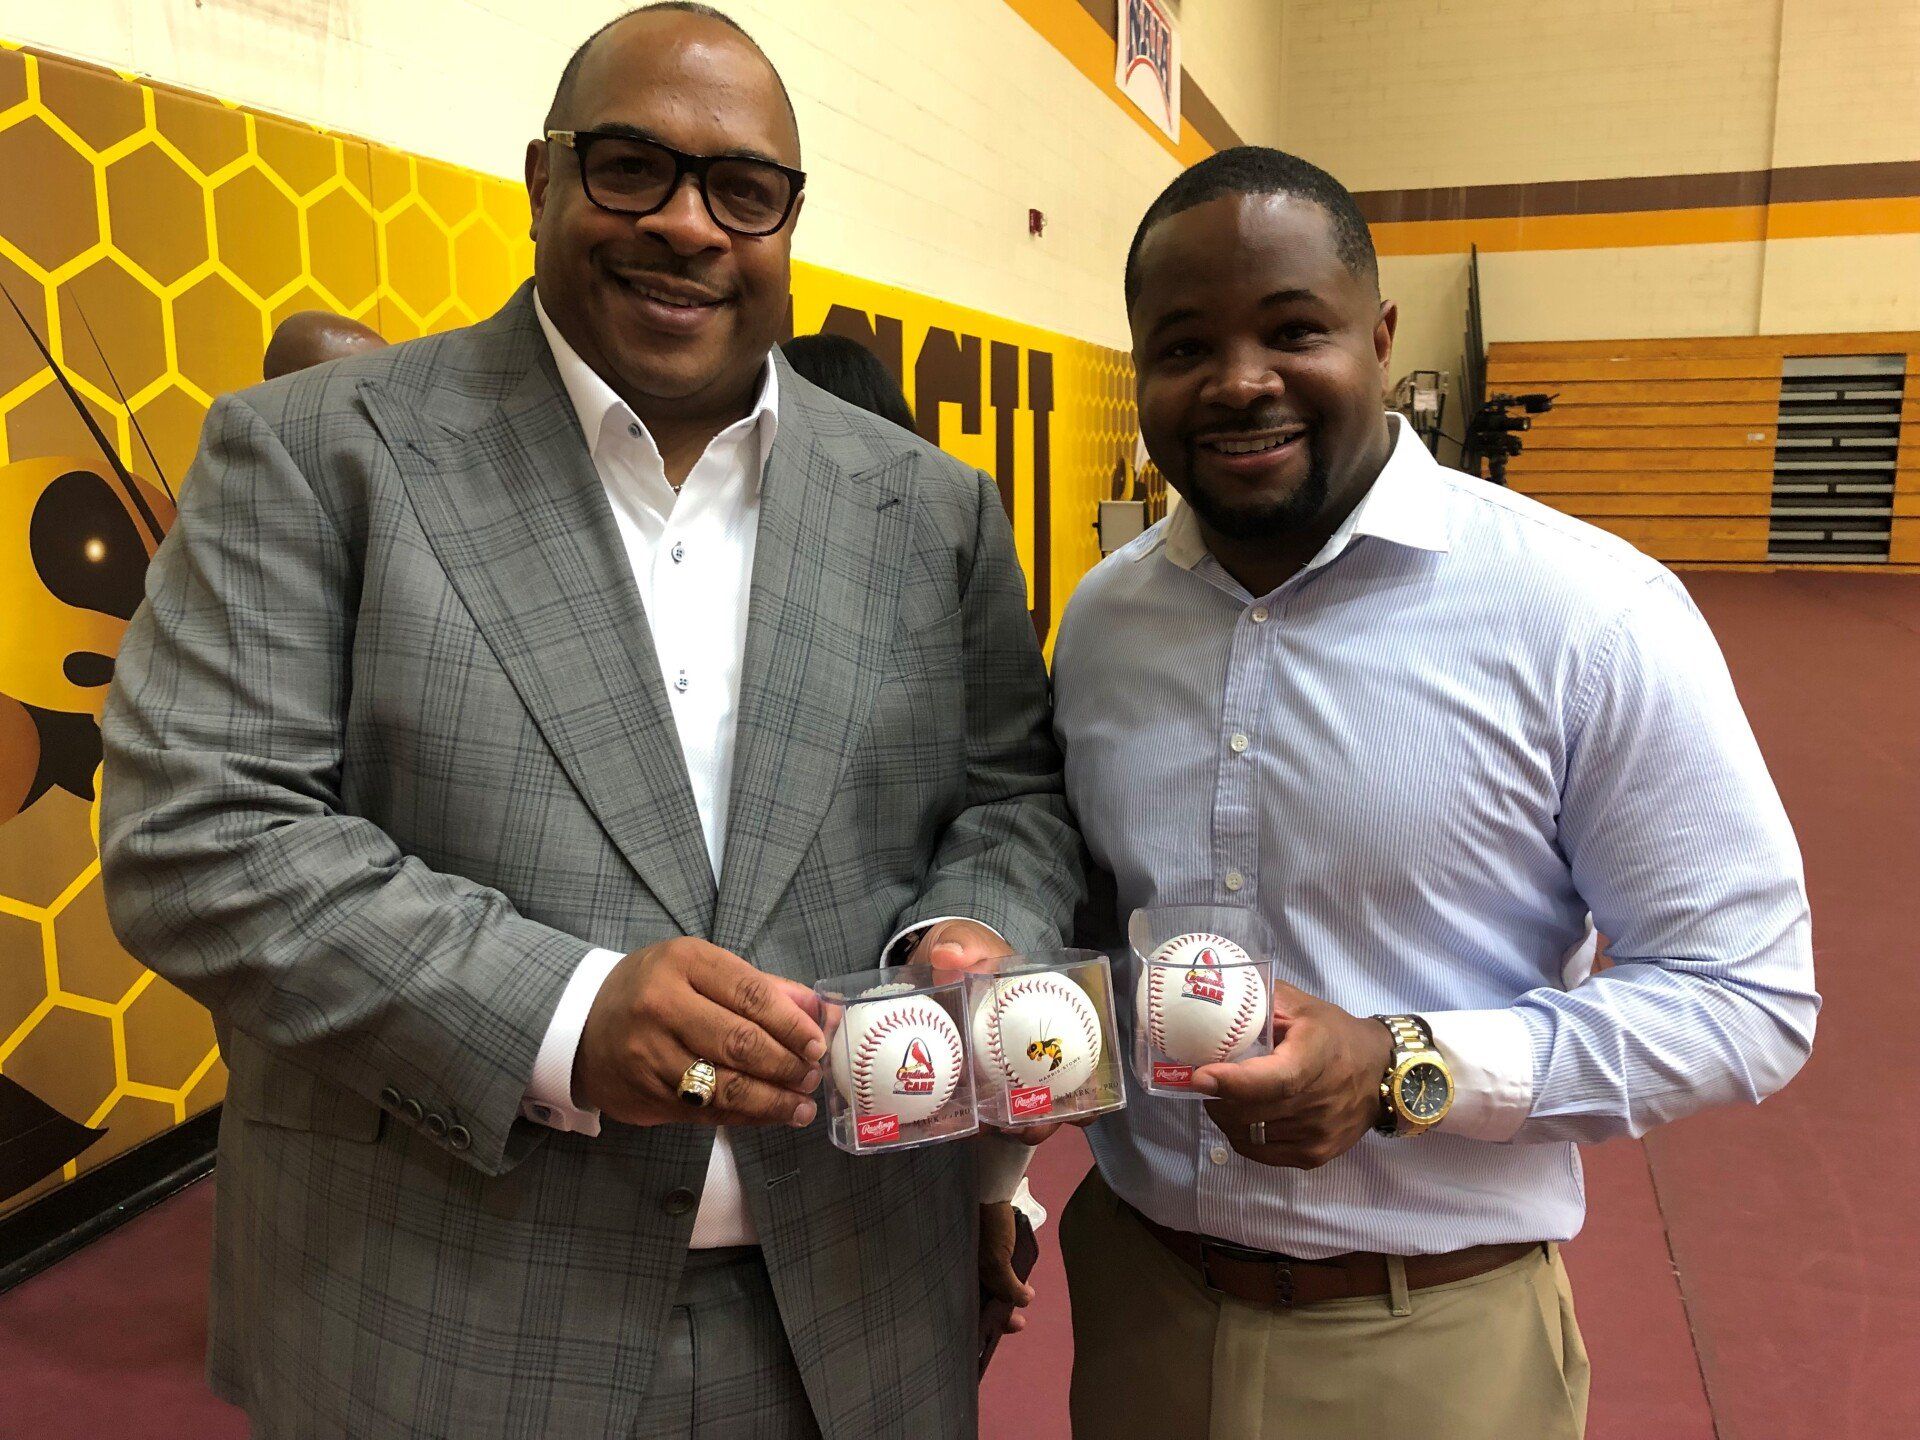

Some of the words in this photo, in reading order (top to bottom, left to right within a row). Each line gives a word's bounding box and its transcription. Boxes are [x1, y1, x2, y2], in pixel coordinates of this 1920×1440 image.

[1193, 983, 1224, 1001] CARE
[904, 1081, 935, 1092] CARE
[1065, 1088, 1091, 1099] MARK
[1103, 1081, 1119, 1091] PRO
[1014, 1093, 1048, 1108] Rawlings
[954, 1107, 971, 1118] PRO
[861, 1120, 895, 1136] Rawlings
